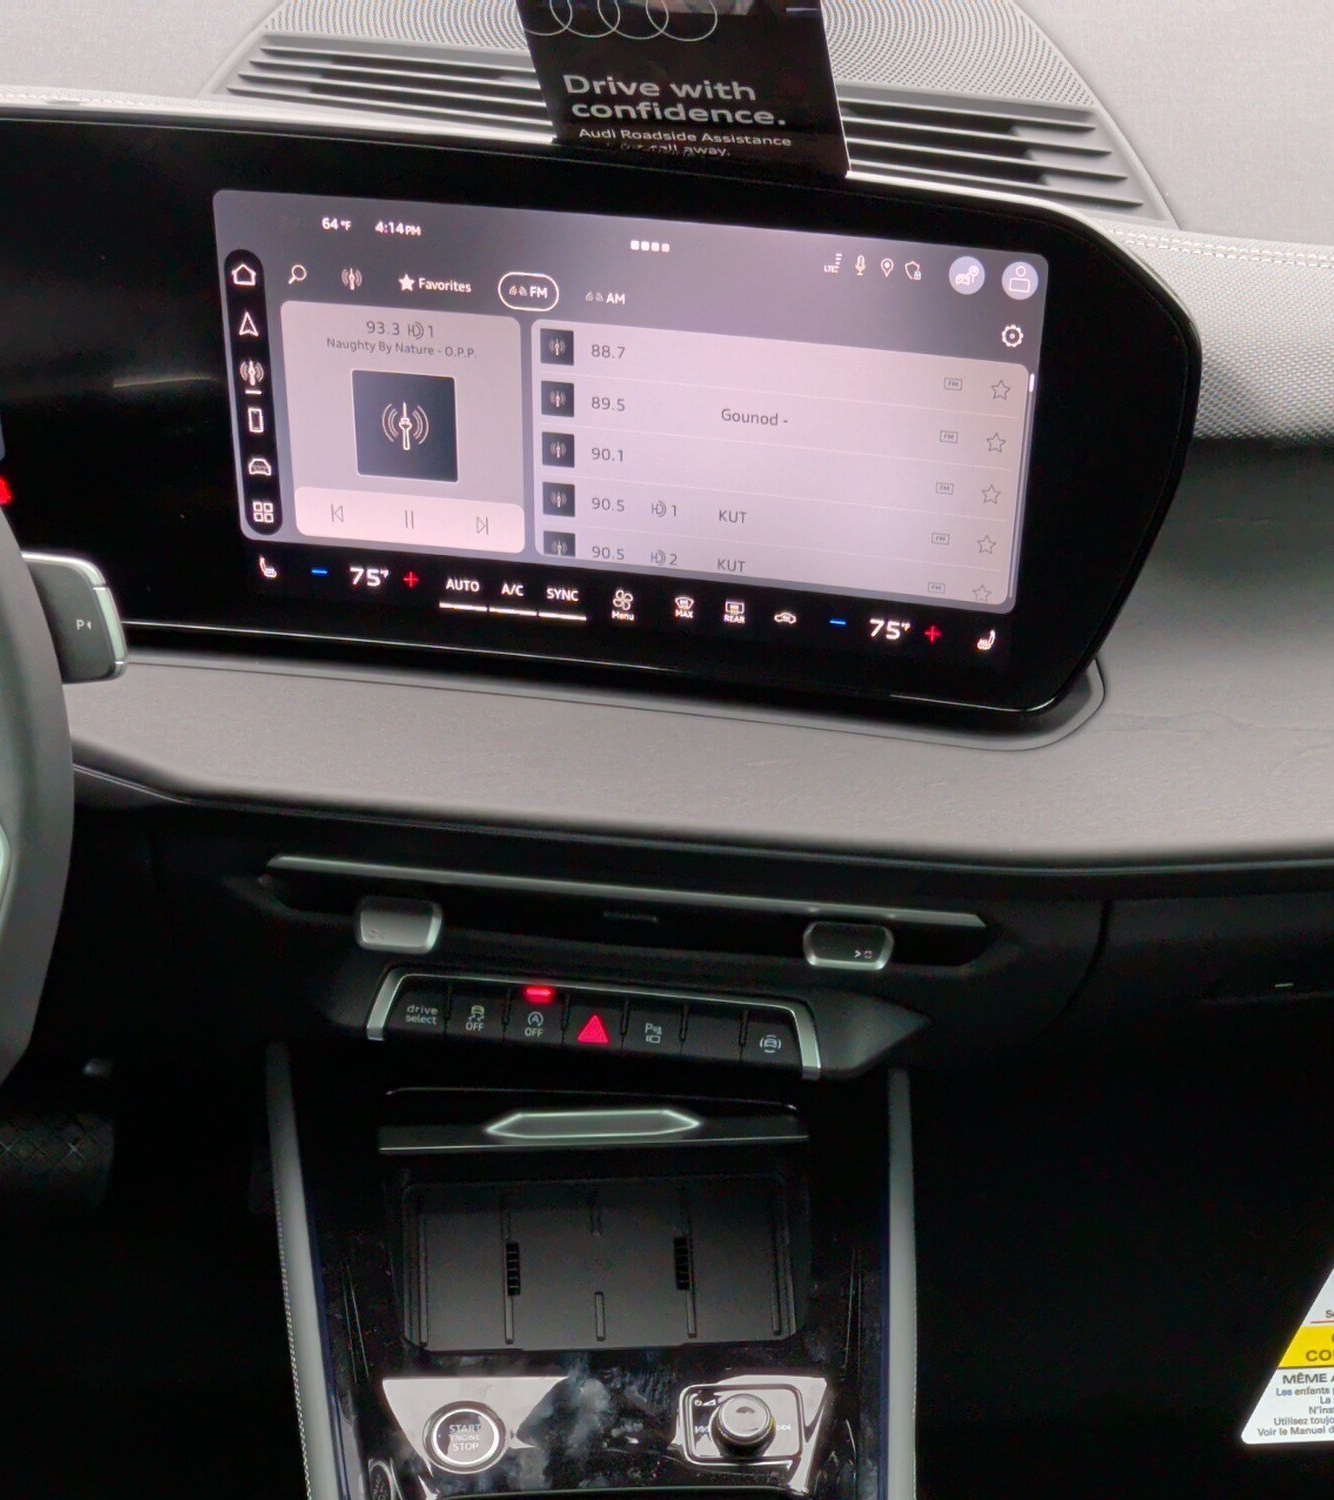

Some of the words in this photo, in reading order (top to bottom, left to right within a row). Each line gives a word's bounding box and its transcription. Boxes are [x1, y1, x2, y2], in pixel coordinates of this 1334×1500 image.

[563, 74, 660, 97] Drive
[670, 80, 757, 101] with
[572, 102, 786, 126] confidence.
[579, 128, 616, 139] Audi
[621, 129, 697, 142] Roadside
[701, 133, 792, 147] Assistance
[418, 278, 472, 293] Favorites
[530, 286, 548, 299] FM
[606, 292, 626, 305] AM
[366, 320, 401, 336] 93.3
[326, 337, 376, 354] Naughty
[378, 341, 393, 356] By
[395, 342, 435, 357] Nature
[591, 344, 625, 360] 88.7
[591, 396, 625, 412] 89.5
[721, 408, 779, 426] Gounod
[591, 447, 624, 462] 90.1
[591, 497, 625, 512] 90.5
[718, 509, 748, 524] KUT
[591, 545, 625, 561] 90.5
[717, 557, 746, 573] KUT
[445, 578, 480, 592] AUTO
[501, 582, 525, 597] A/C
[546, 587, 579, 602] SYNC
[611, 610, 635, 621] Menu
[675, 609, 694, 620] MAX
[723, 614, 746, 624] REAR
[76, 619, 85, 630] P
[406, 1004, 439, 1016] drive
[405, 1014, 438, 1026] select
[465, 1021, 485, 1032] OFF
[525, 1026, 544, 1038] OFF
[1283, 1372, 1327, 1384] MÊME
[449, 1424, 481, 1434] START
[453, 1442, 479, 1452] STOP
